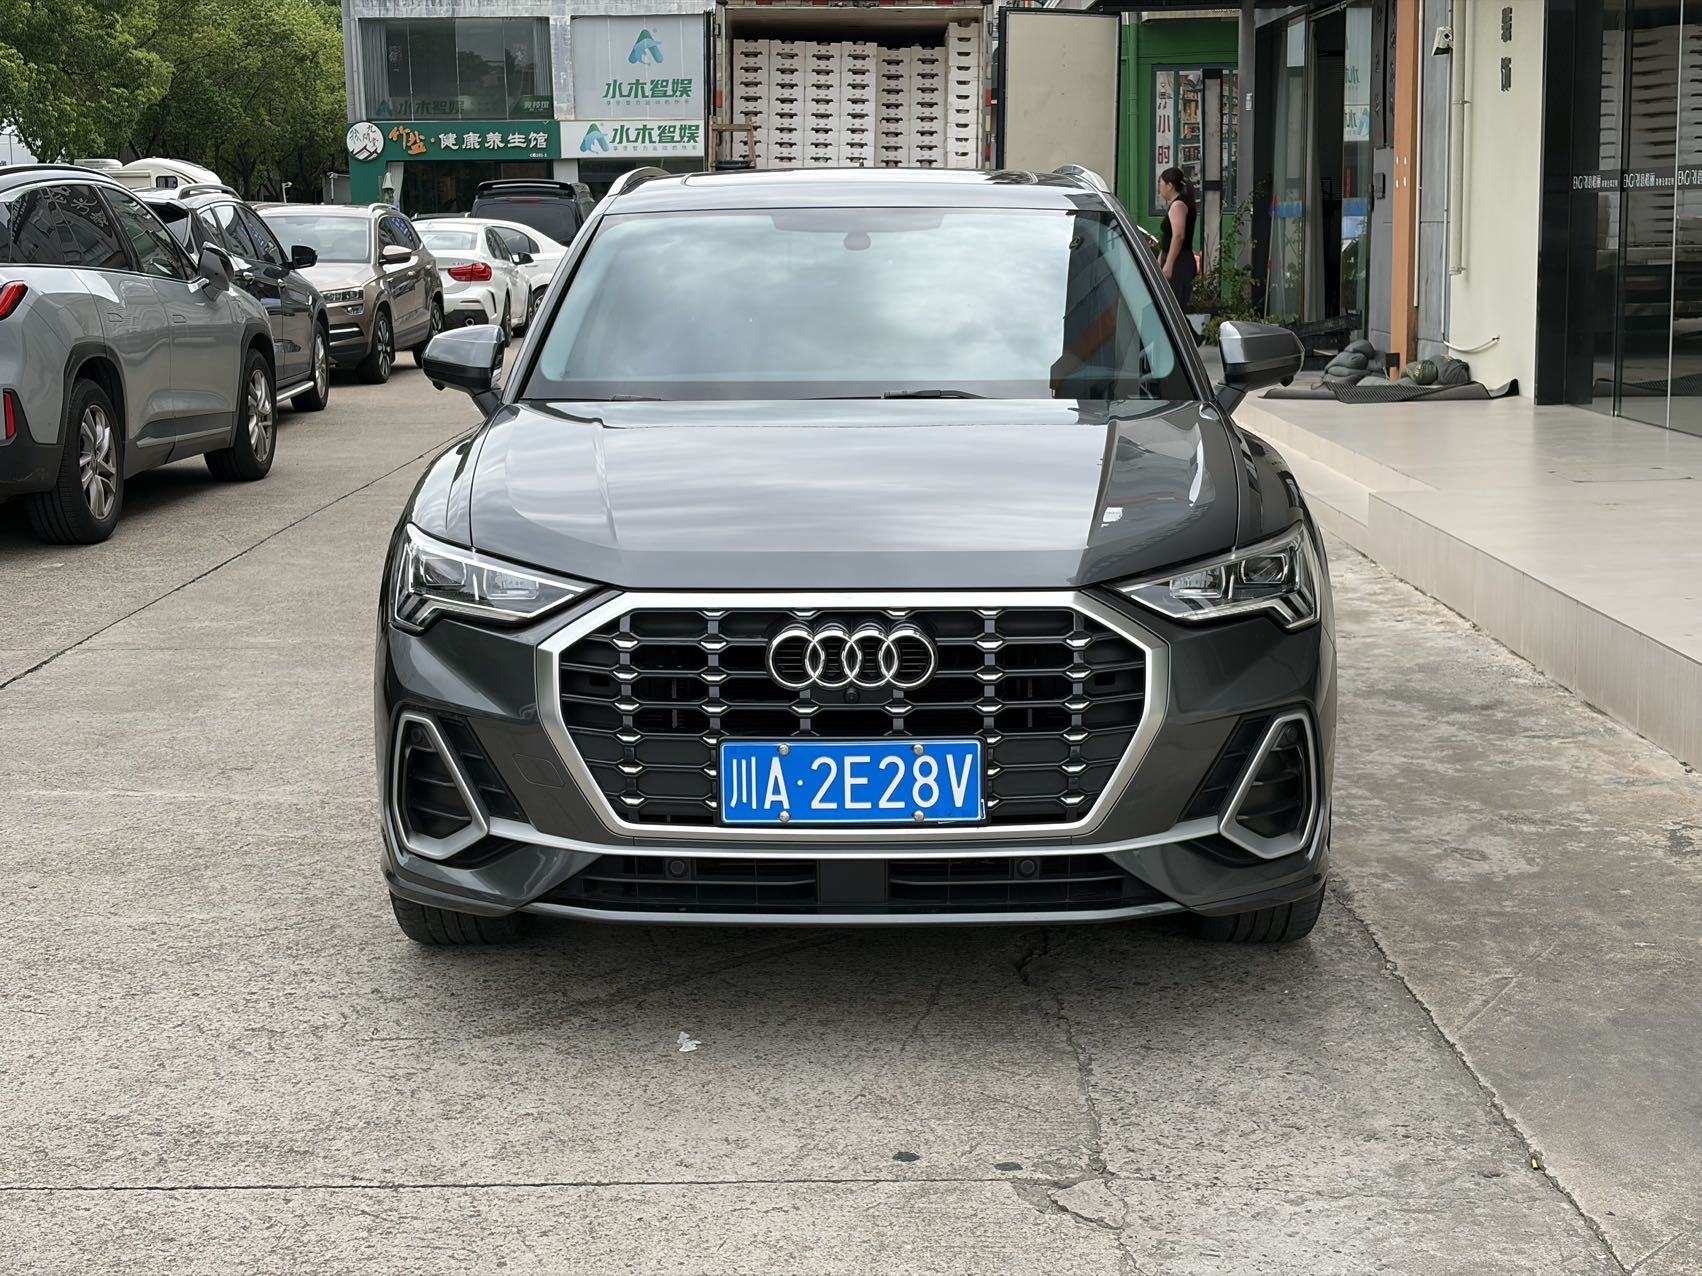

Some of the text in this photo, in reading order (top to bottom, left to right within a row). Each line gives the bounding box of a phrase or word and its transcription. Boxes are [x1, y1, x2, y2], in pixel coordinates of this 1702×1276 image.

[603, 79, 692, 99] 水木智娱
[609, 124, 700, 144] 水木智娱
